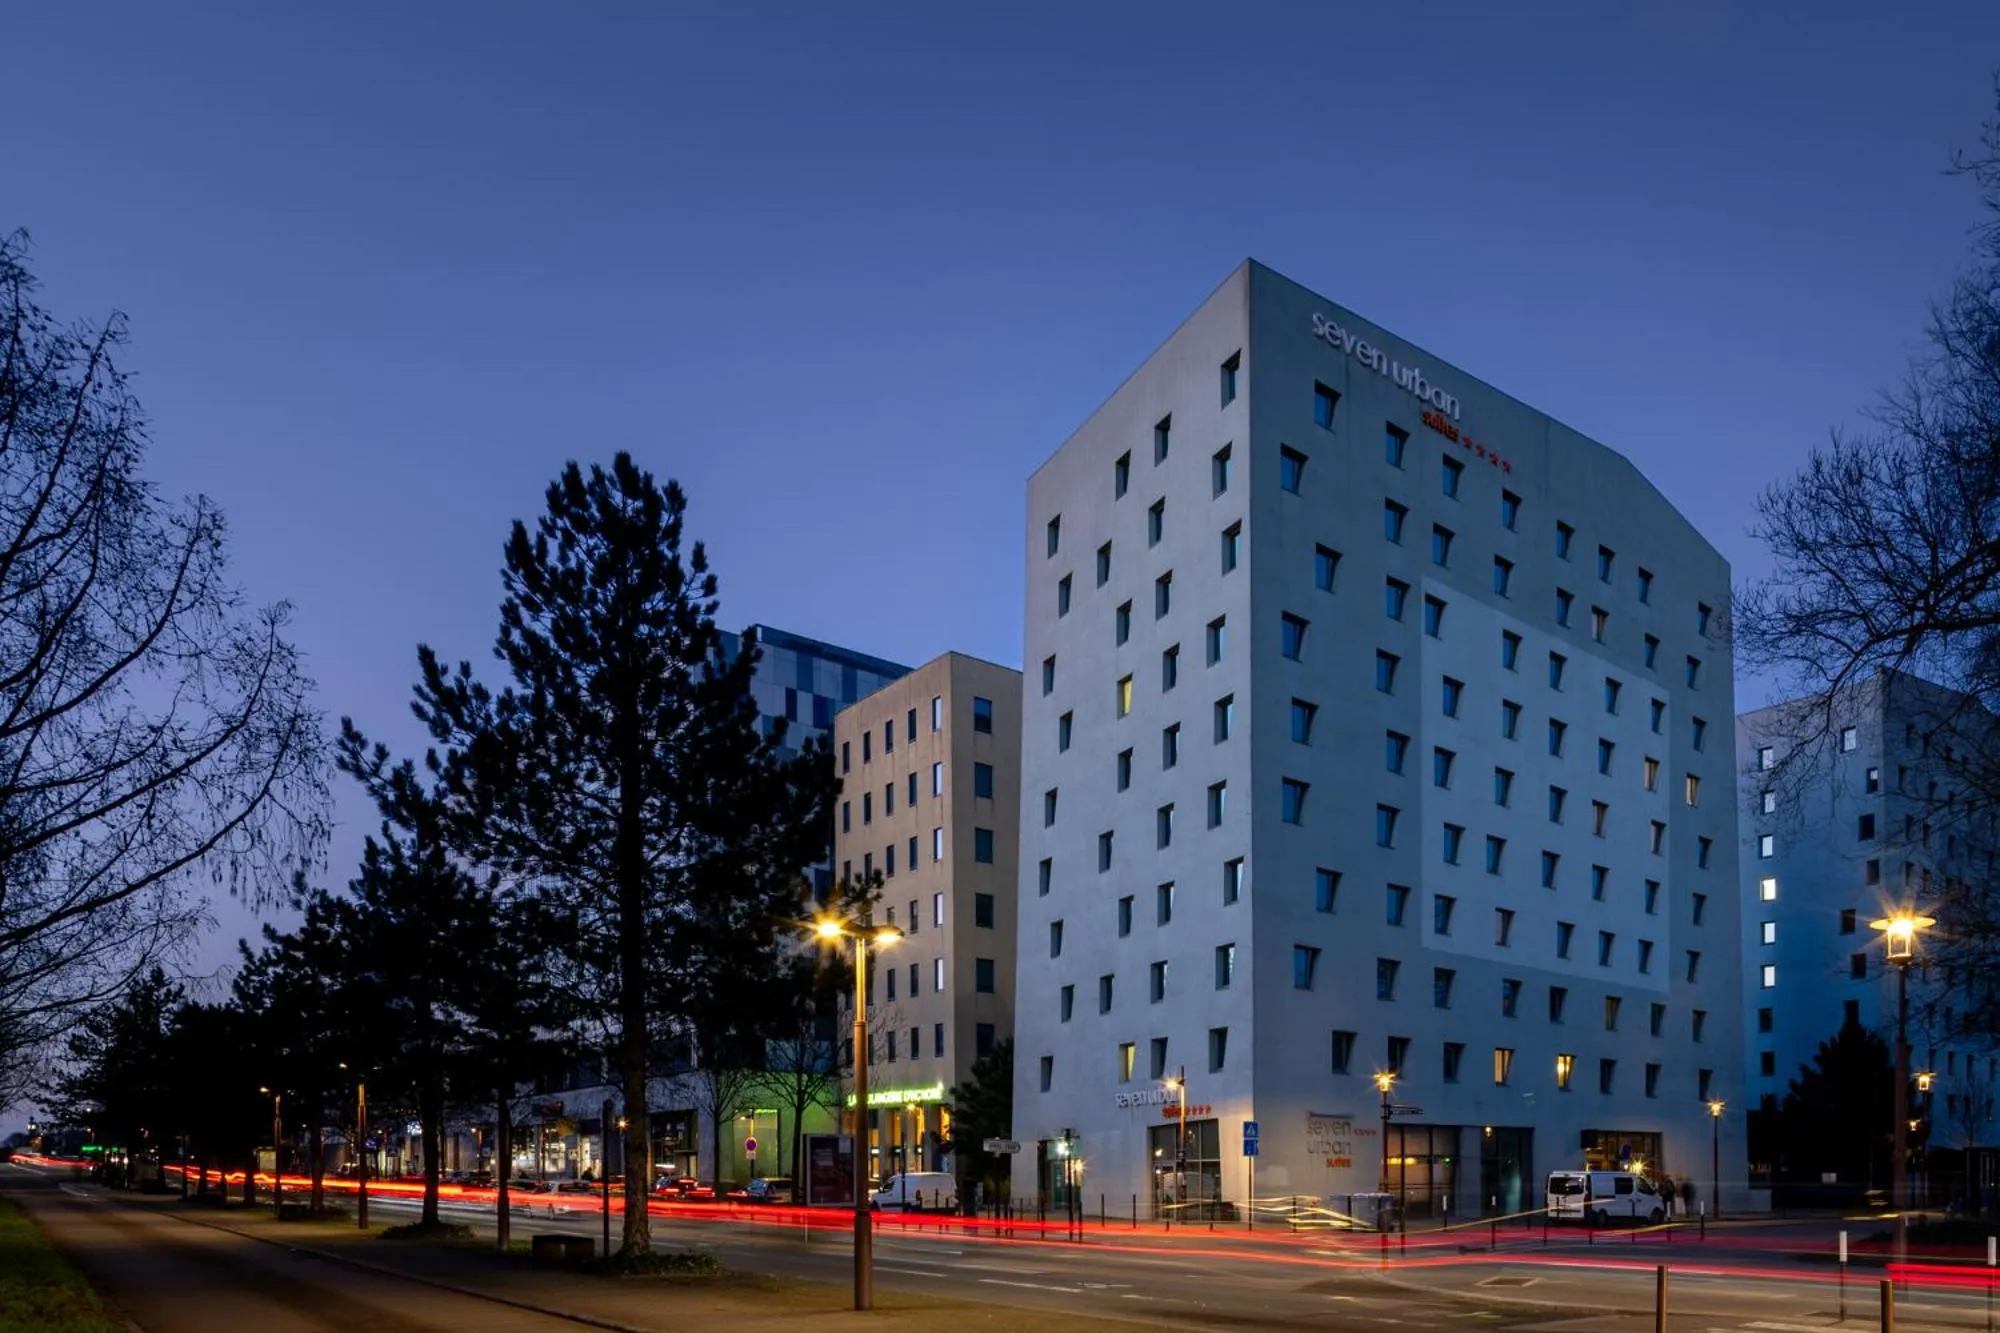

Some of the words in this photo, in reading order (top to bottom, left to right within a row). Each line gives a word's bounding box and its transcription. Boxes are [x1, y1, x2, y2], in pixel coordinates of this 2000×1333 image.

[1312, 312, 1387, 376] seven
[1392, 360, 1460, 420] urban
[1306, 1118, 1352, 1136] seven
[1307, 1138, 1352, 1155] urban
